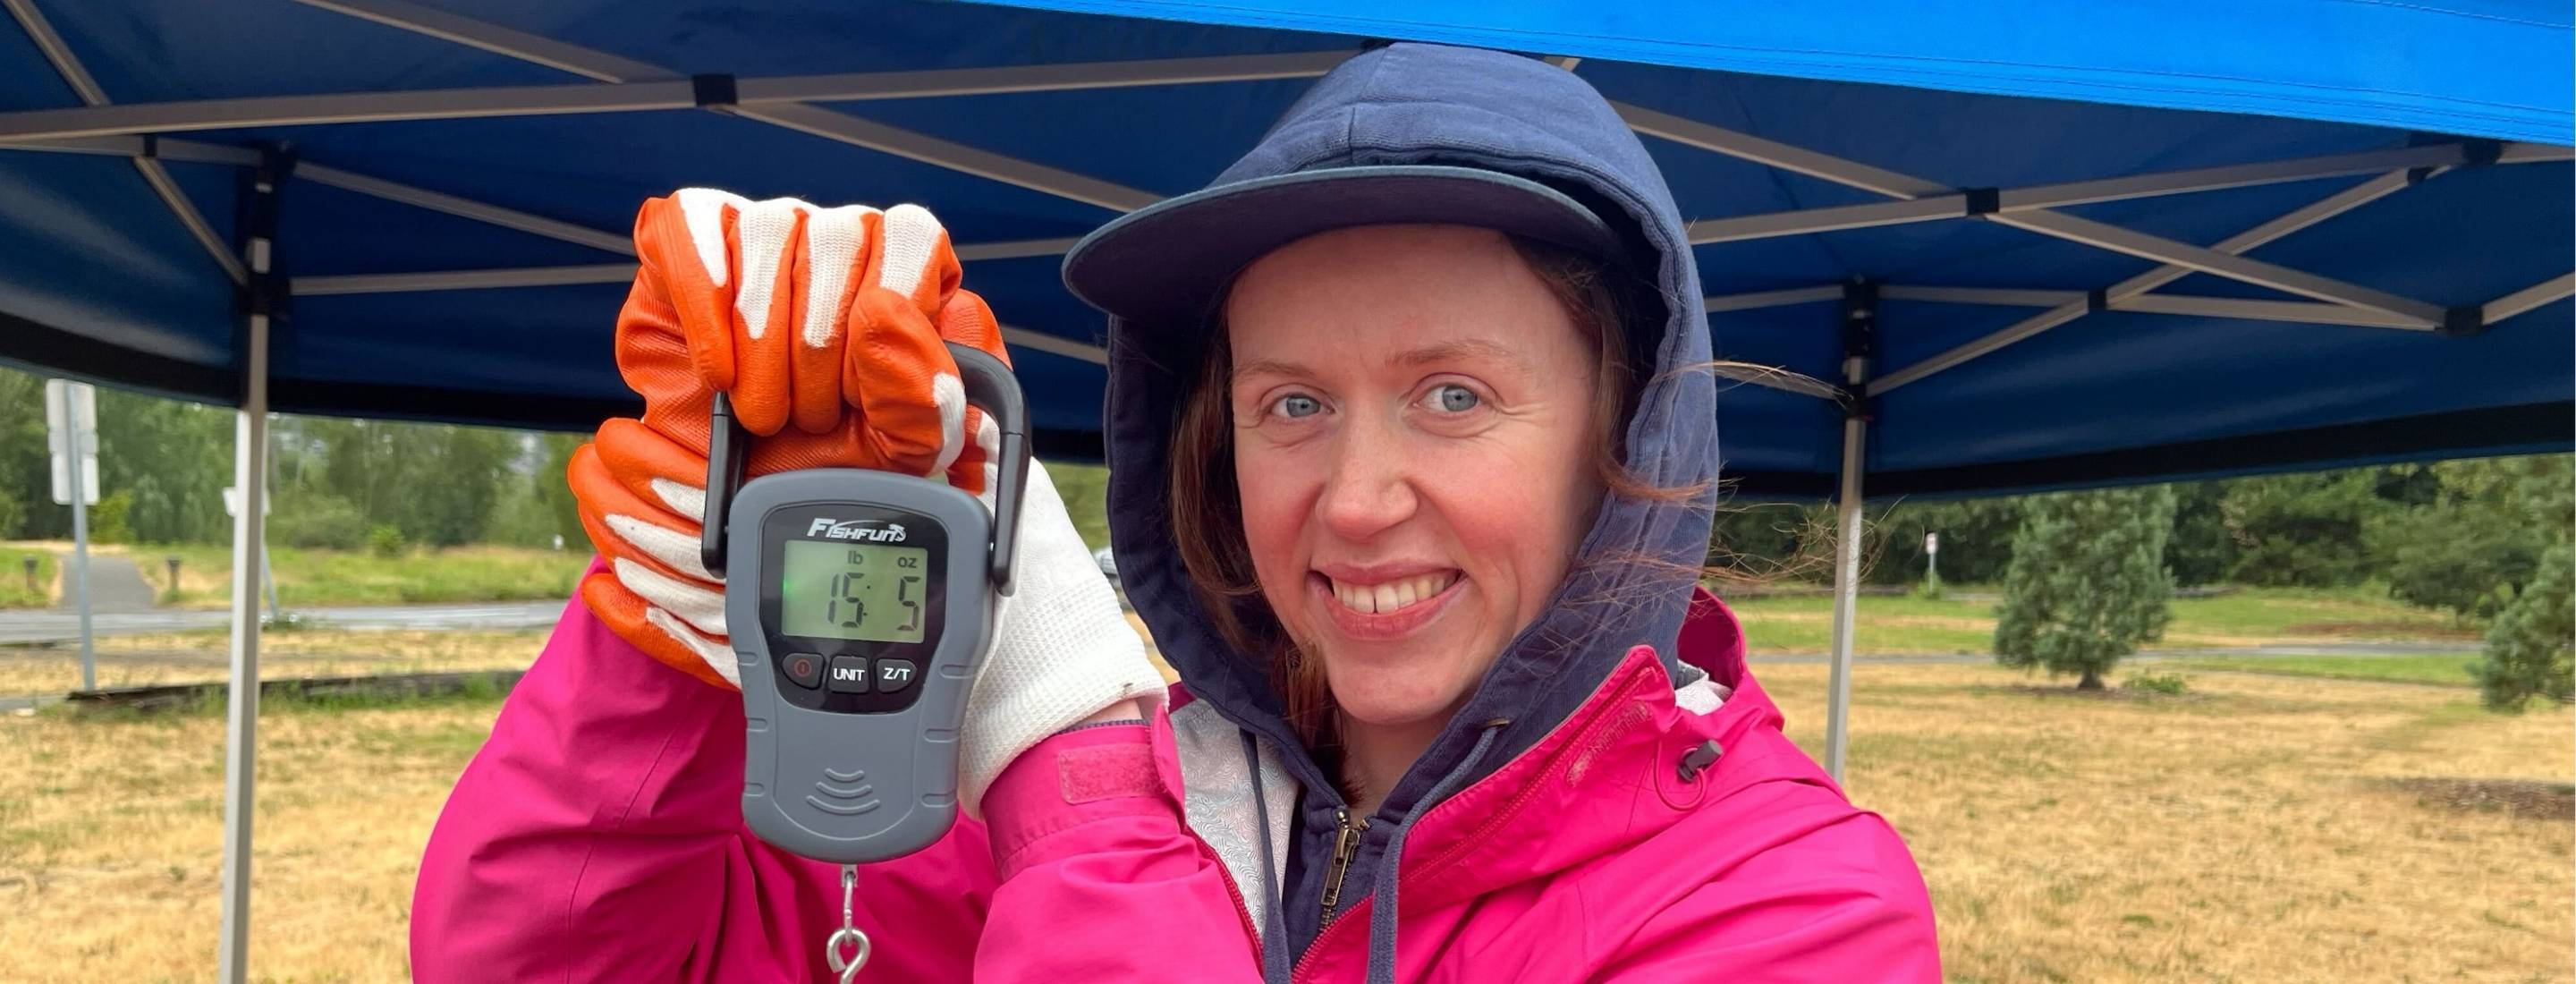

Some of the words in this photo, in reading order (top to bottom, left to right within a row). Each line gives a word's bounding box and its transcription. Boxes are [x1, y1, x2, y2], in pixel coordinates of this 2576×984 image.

[848, 550, 864, 565] lb
[897, 556, 917, 568] oz
[897, 576, 920, 632] 5
[833, 667, 865, 682] UNIT
[883, 667, 911, 681] Z/T
